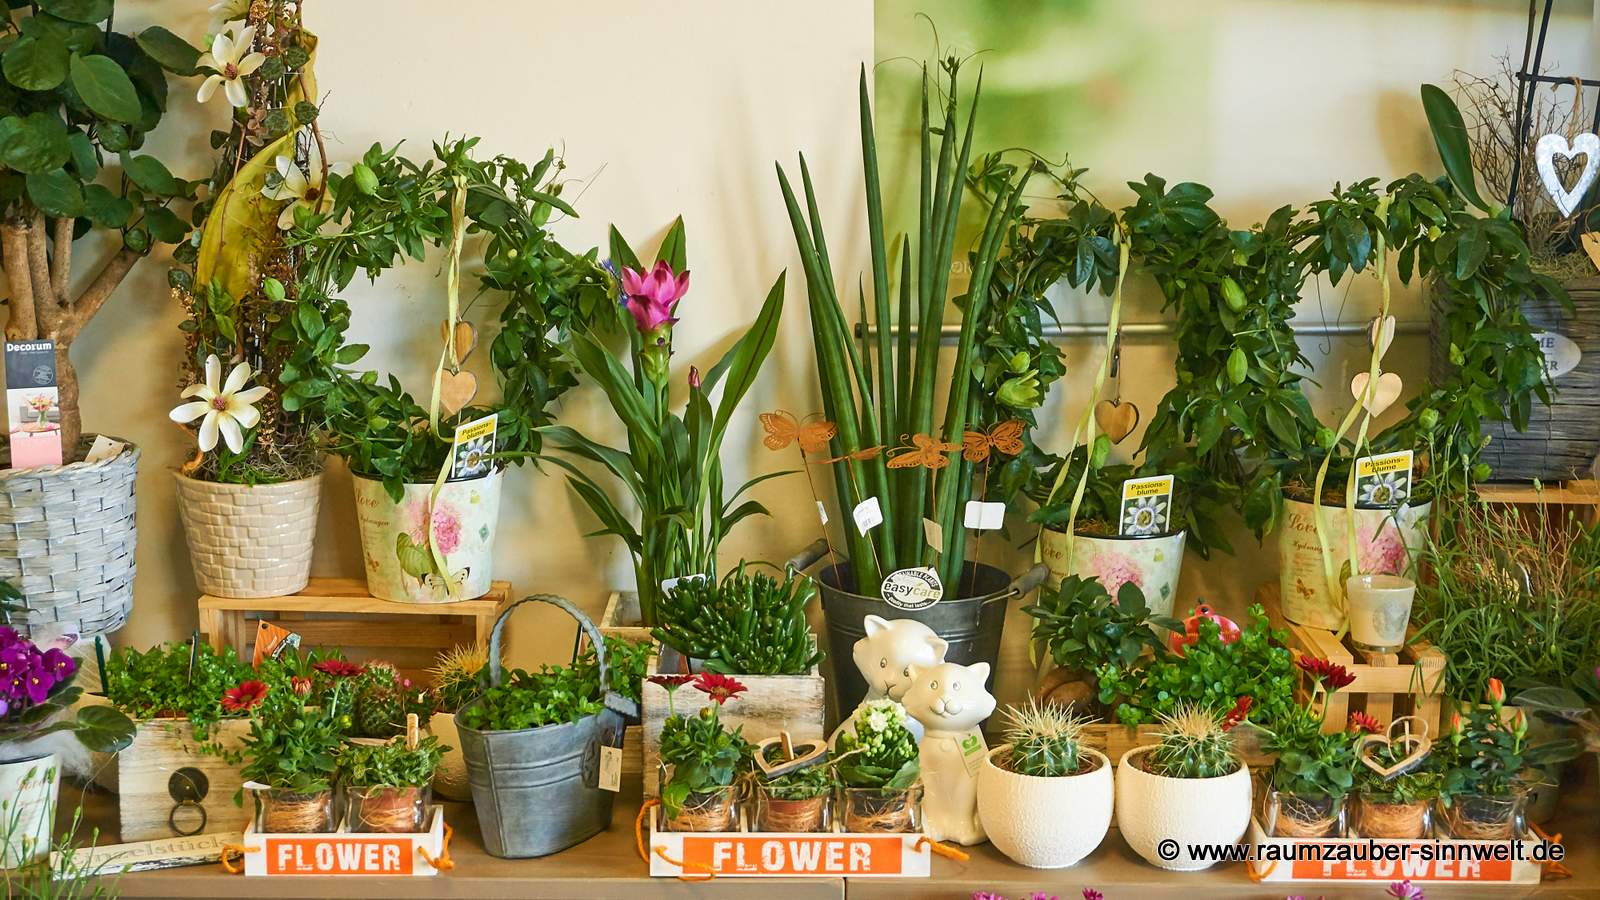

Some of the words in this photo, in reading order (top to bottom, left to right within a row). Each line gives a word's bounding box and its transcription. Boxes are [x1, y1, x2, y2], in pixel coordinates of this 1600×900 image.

[6, 342, 52, 352] Decorum
[1131, 482, 1166, 491] Passions-
[1288, 512, 1318, 533] Lov
[884, 582, 941, 599] easycare
[278, 843, 401, 871] FLOWER
[713, 841, 872, 871] FLOWER
